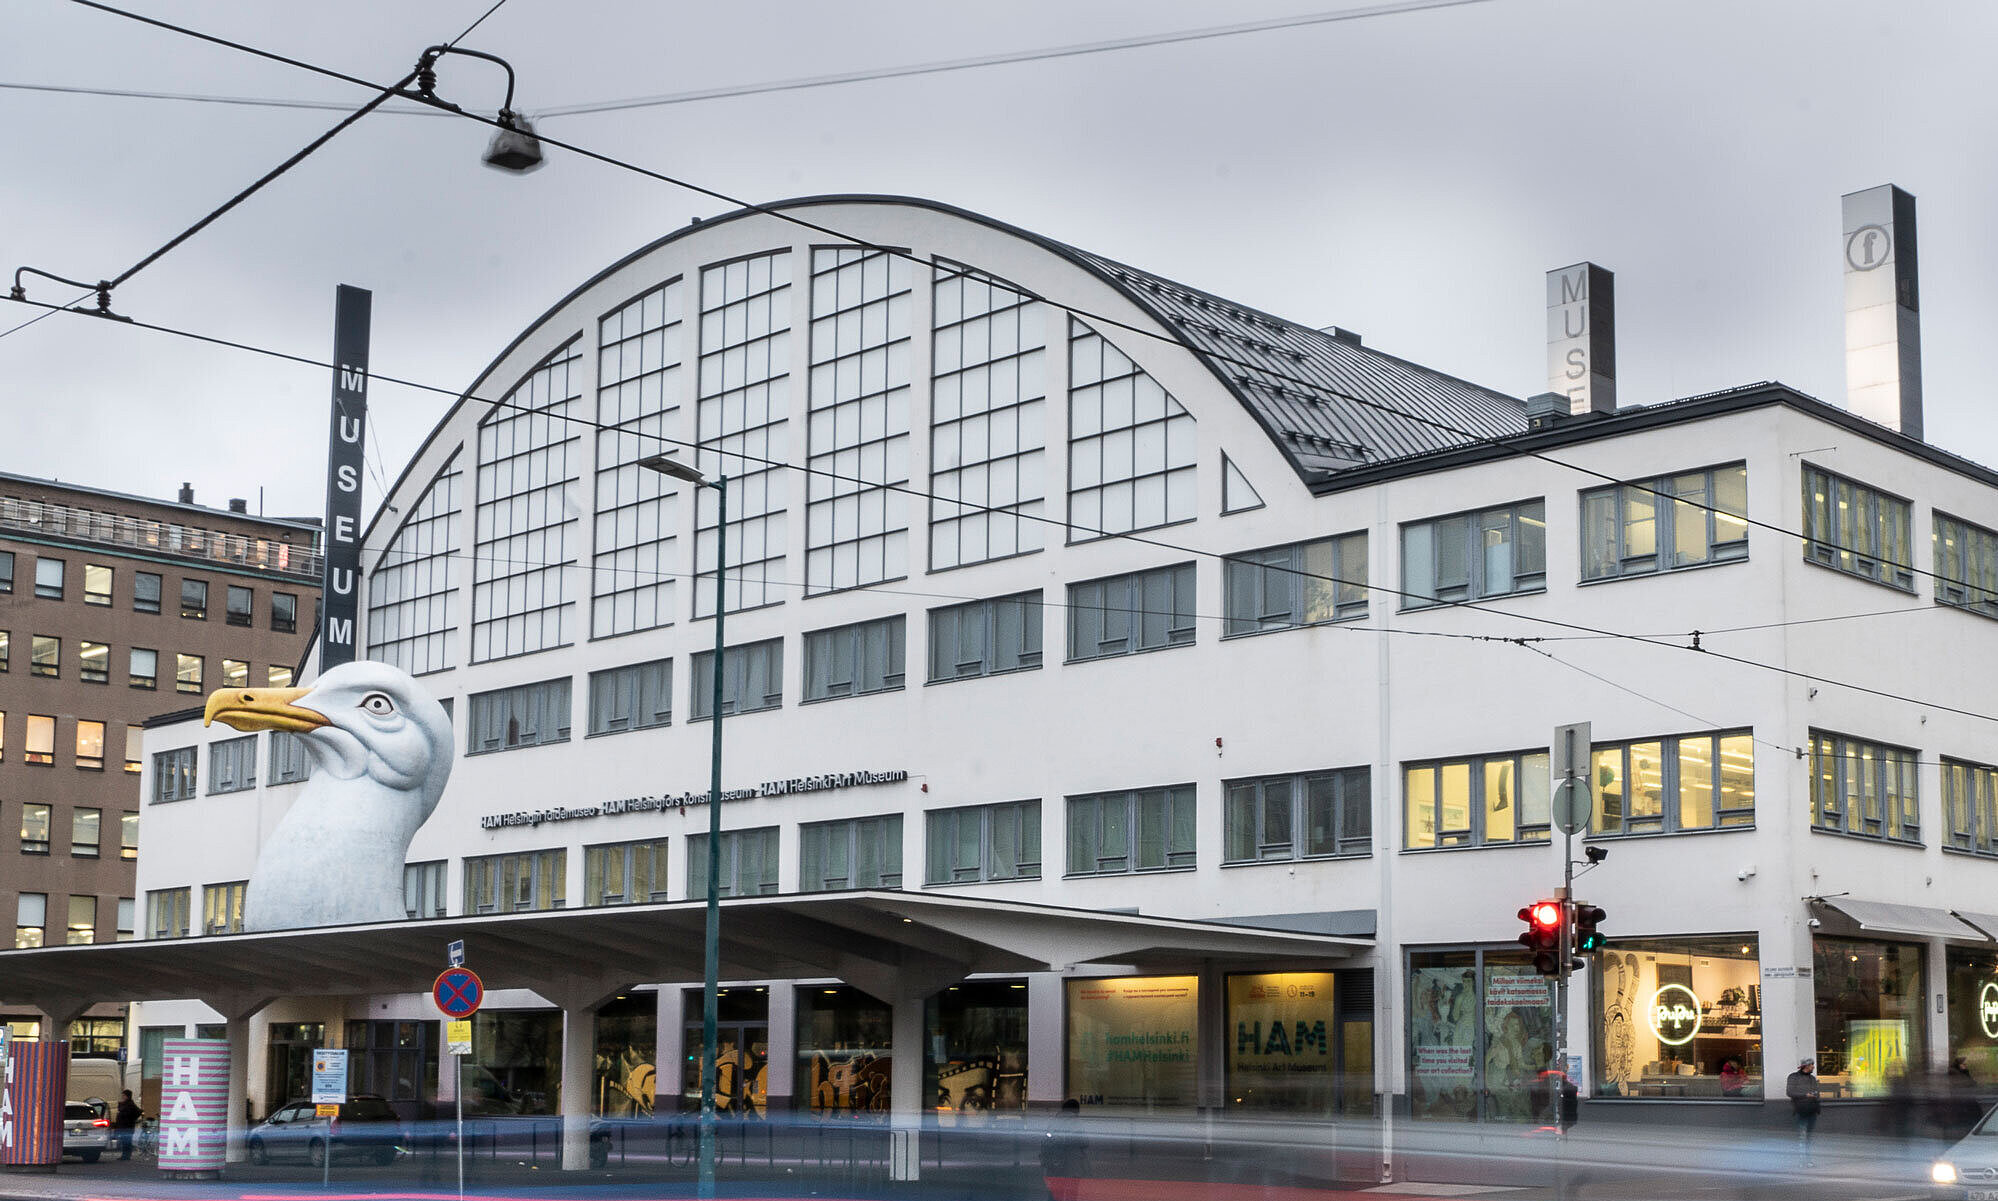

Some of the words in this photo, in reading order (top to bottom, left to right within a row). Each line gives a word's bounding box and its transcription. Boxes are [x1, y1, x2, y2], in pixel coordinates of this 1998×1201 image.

[329, 364, 364, 645] MUSEUM
[760, 782, 787, 797] HAM
[790, 774, 831, 793] Helsinki
[834, 773, 852, 789] Art
[854, 770, 905, 786] Museum
[481, 814, 502, 828] HAM
[504, 810, 542, 826] Helsingin
[545, 806, 597, 822] taidemuseo
[602, 799, 626, 814] HAM
[628, 794, 680, 812] Helsingfors
[1237, 1020, 1327, 1056] HAM
[166, 1056, 200, 1156] HAM
[1080, 1094, 1104, 1105] HAM
